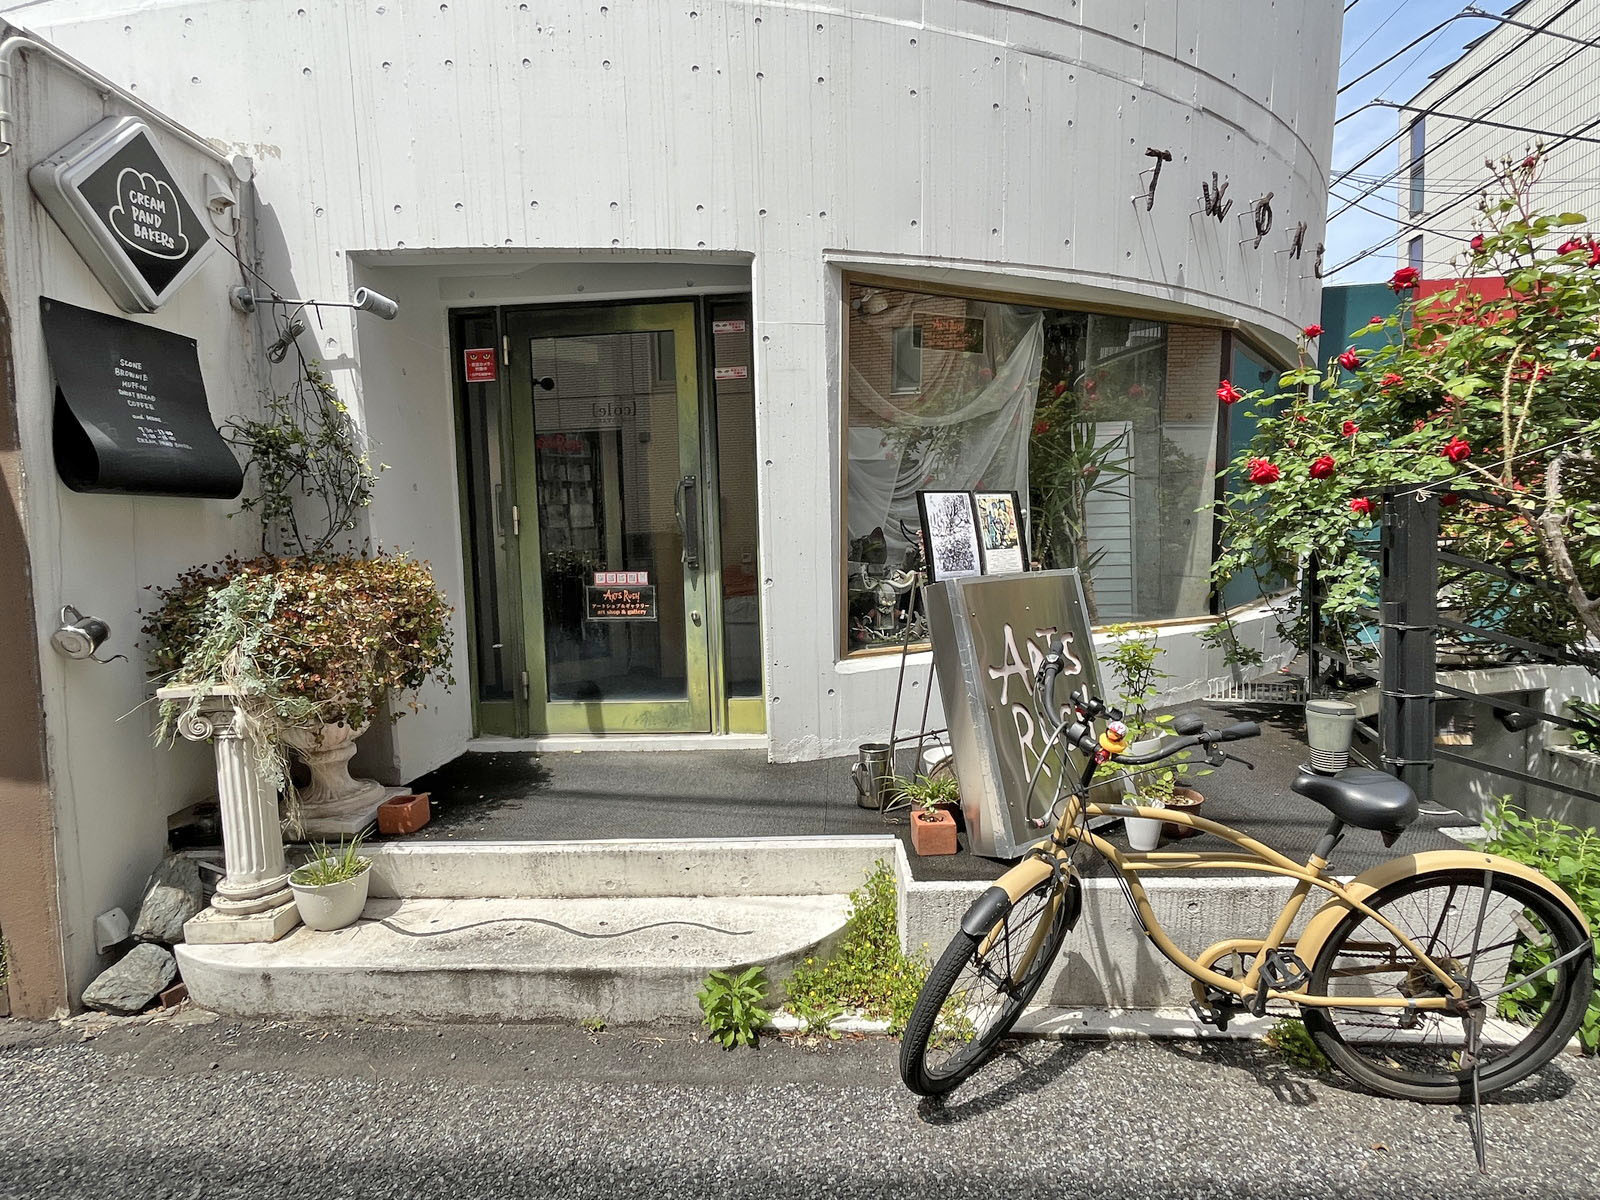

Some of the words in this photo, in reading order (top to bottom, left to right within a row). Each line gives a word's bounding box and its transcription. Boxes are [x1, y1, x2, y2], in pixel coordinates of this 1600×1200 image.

[129, 190, 166, 214] CREAM
[131, 205, 162, 229] PAND
[133, 223, 175, 249] BAKERS
